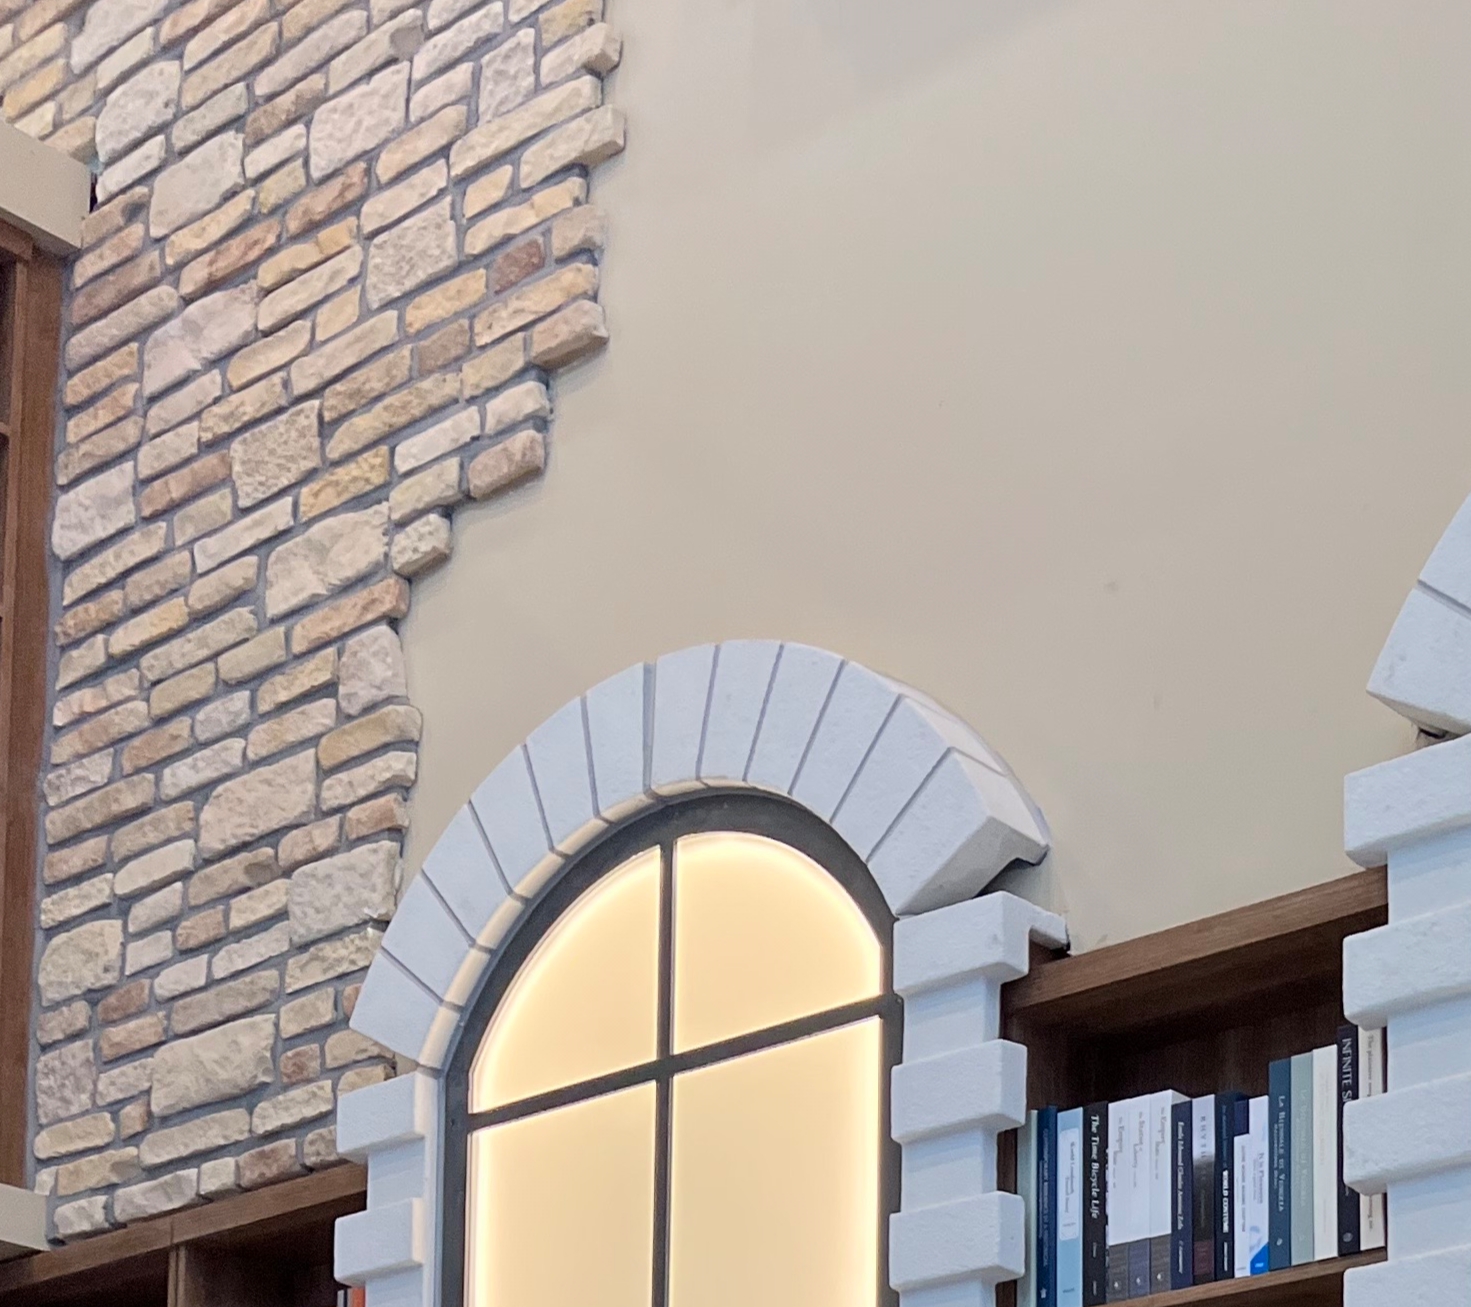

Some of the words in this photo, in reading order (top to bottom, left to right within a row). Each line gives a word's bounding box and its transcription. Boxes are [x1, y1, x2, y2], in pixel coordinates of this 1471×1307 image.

[1341, 1038, 1352, 1088] INFINITE
[1089, 1114, 1100, 1133] The
[1089, 1136, 1100, 1160] Time
[1088, 1162, 1100, 1198] Bicycle
[1089, 1200, 1100, 1219] Life
